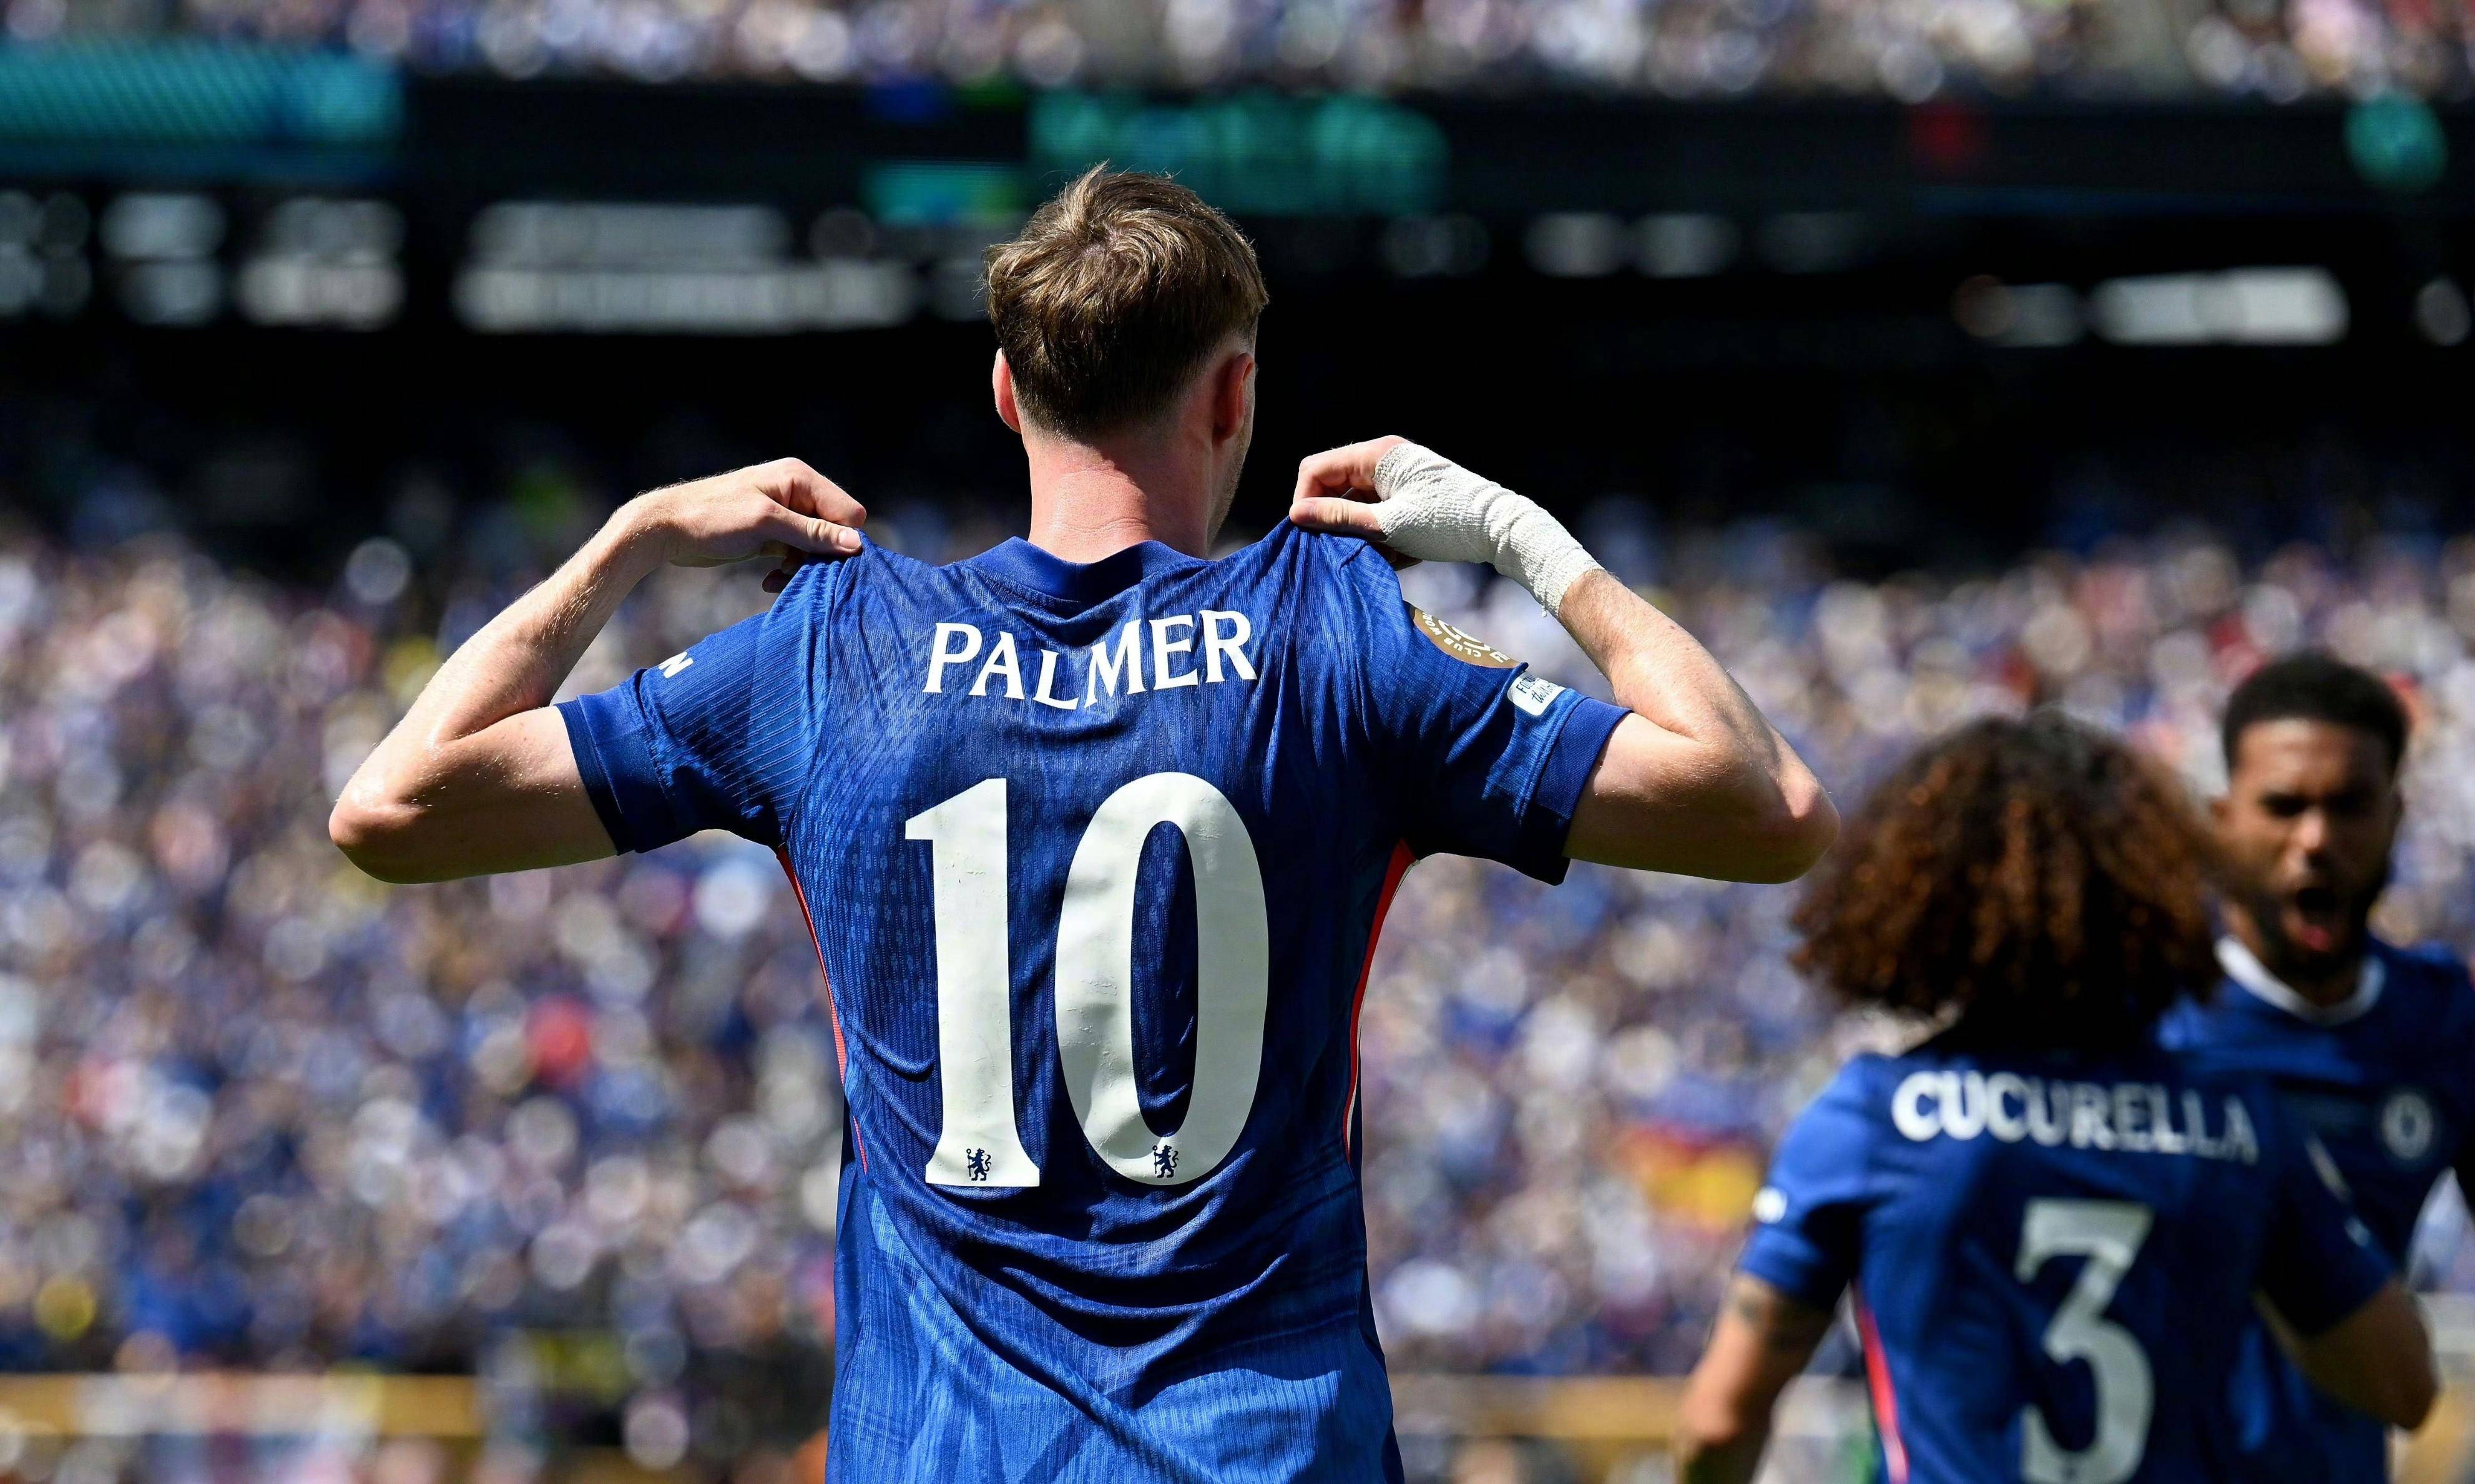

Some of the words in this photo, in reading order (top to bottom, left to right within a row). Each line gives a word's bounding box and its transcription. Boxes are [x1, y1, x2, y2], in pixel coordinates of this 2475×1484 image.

[922, 609, 1257, 710] PALMER
[1443, 637, 1482, 658] CLUB
[904, 771, 1269, 1187] 10
[1891, 1069, 2258, 1165] CUCURELLA
[2014, 1197, 2155, 1484] 3
